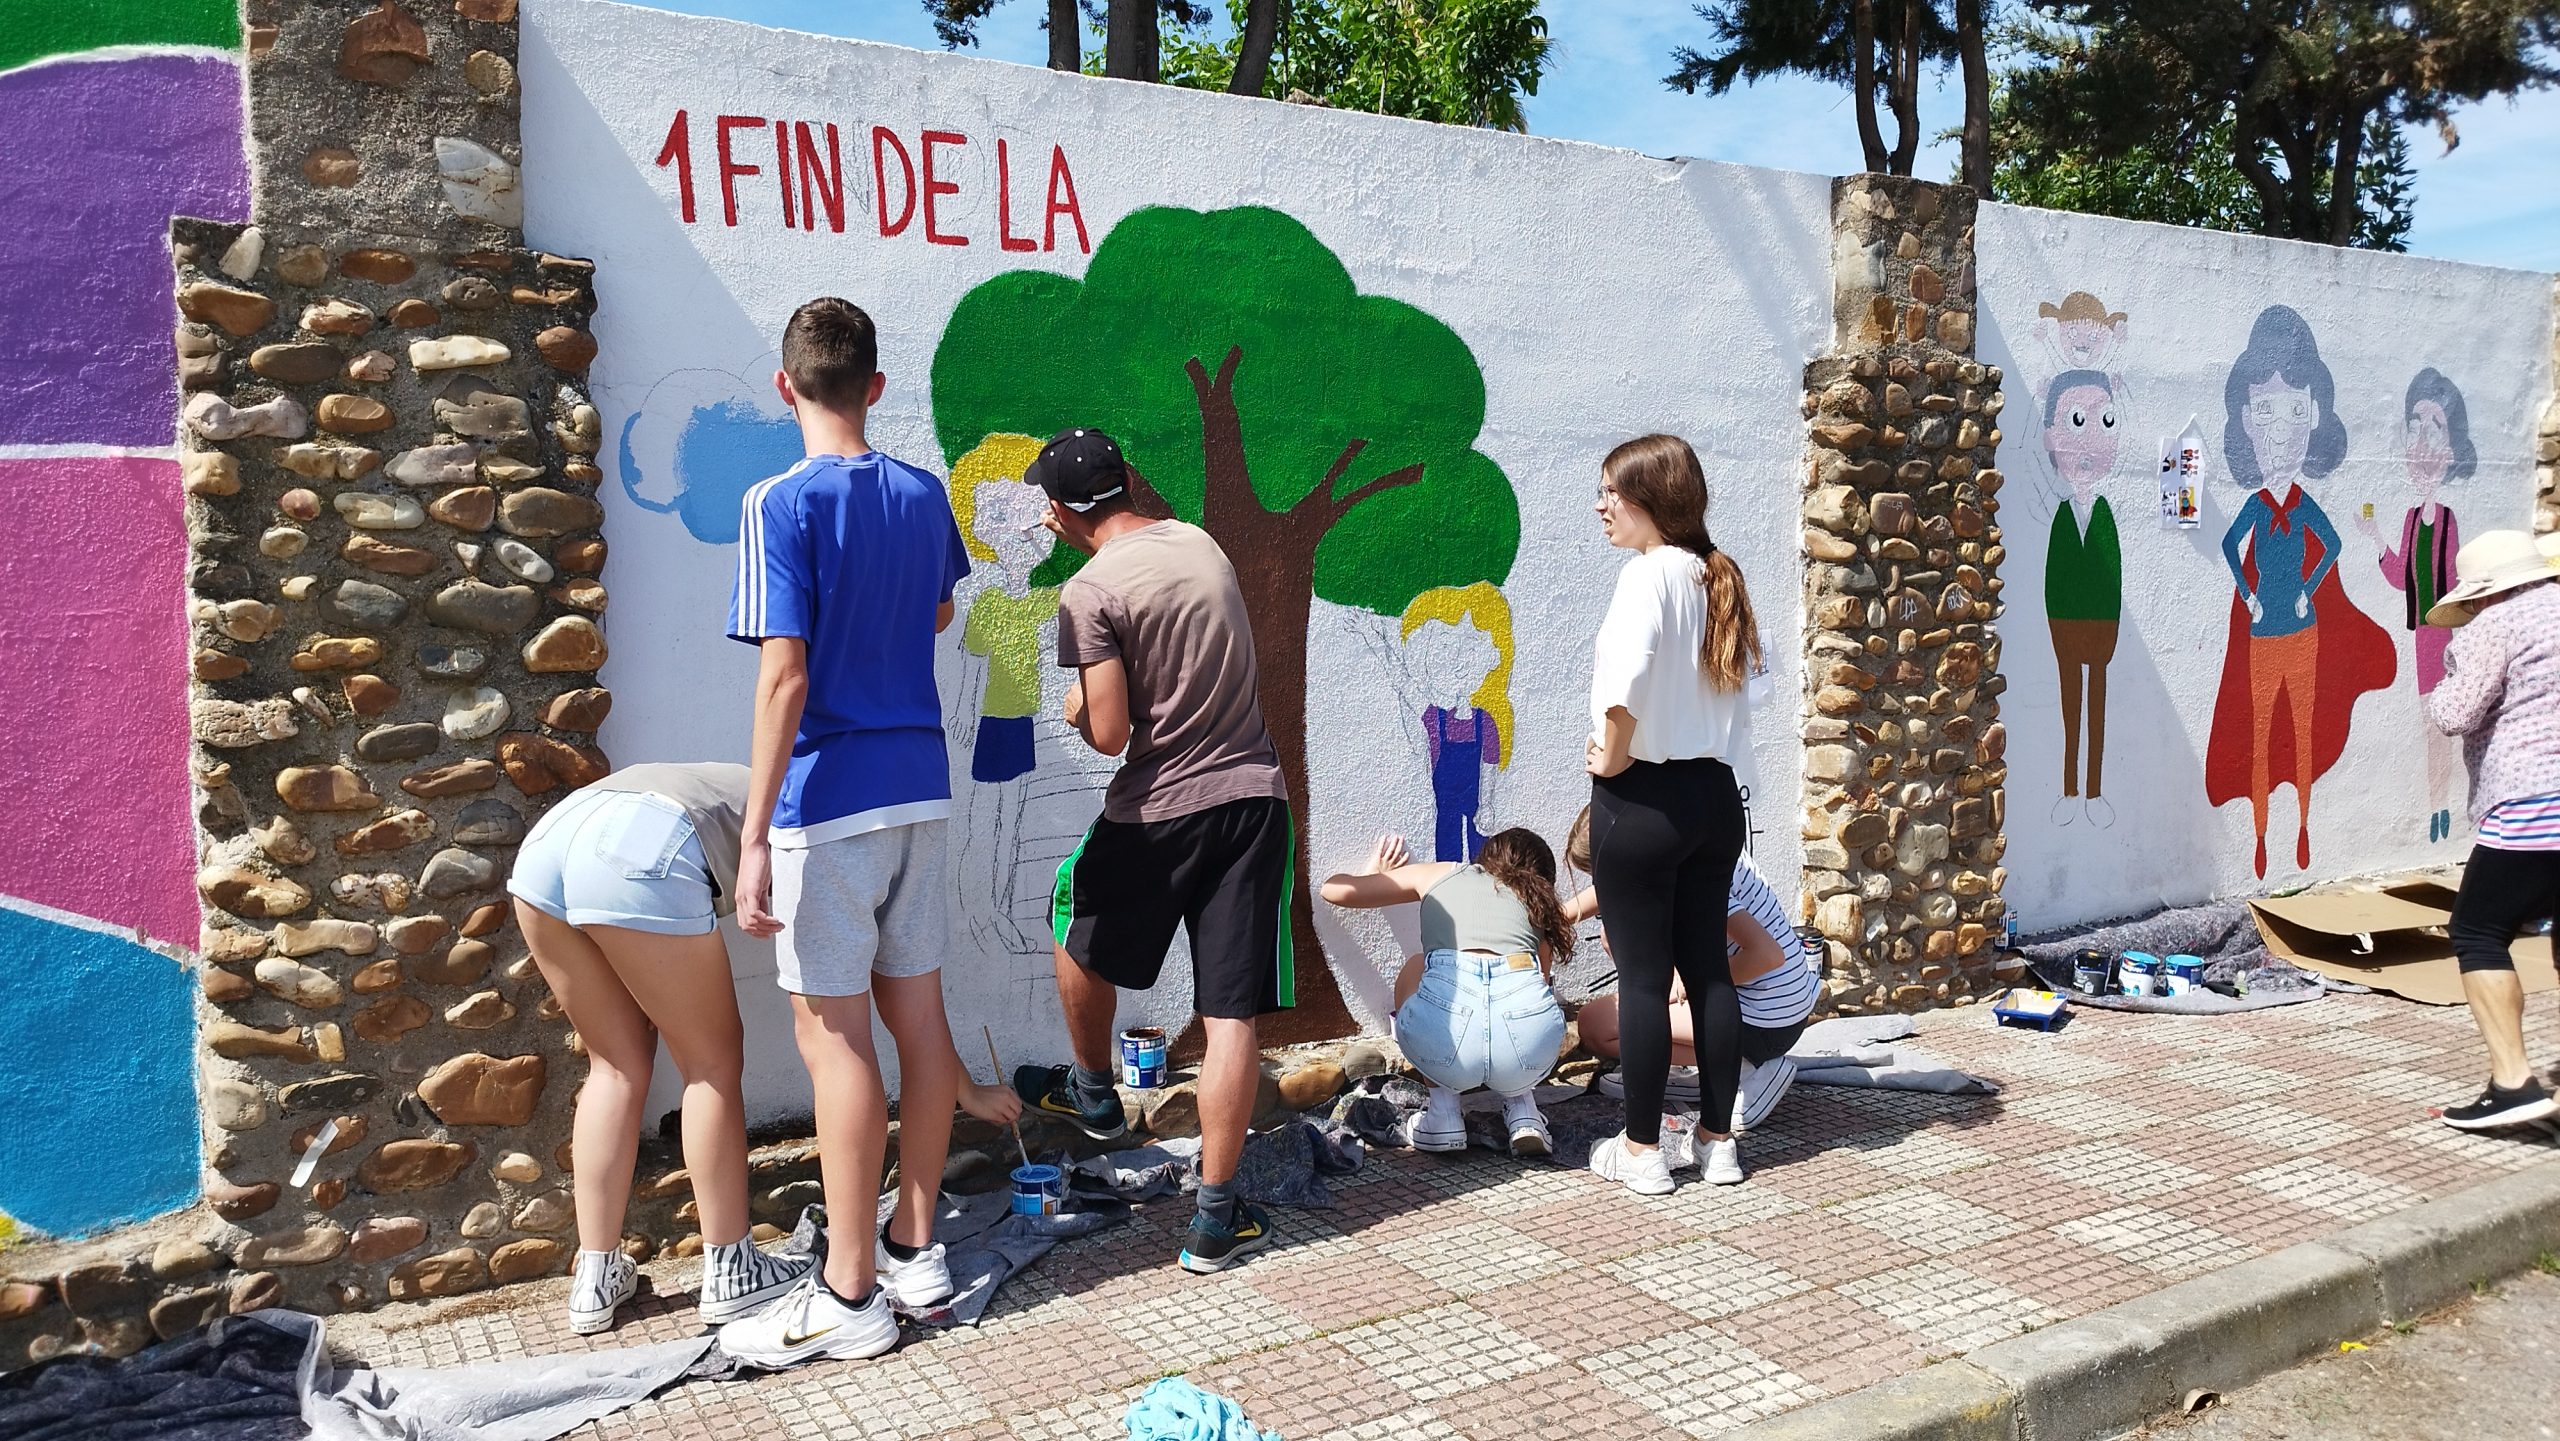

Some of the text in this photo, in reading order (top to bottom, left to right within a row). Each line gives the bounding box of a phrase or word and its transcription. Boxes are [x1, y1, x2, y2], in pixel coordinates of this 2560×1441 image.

[656, 109, 1091, 255] 1 FIN DE LA
